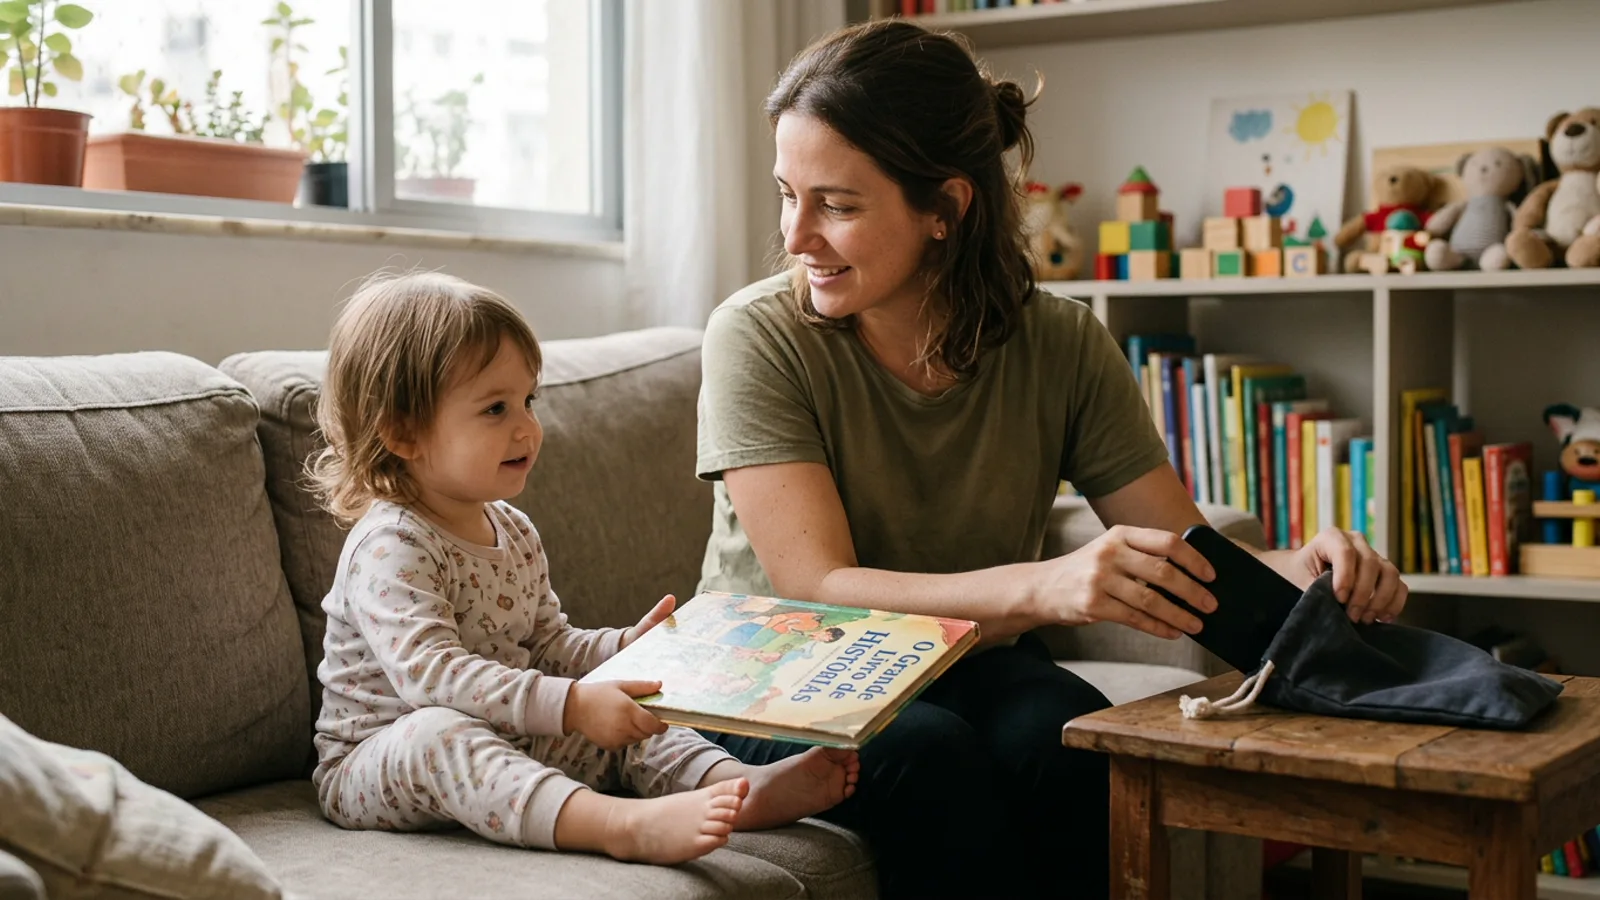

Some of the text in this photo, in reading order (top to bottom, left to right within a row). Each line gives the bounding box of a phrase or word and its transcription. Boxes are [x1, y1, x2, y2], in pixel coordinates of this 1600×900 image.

[1292, 253, 1308, 274] C
[912, 641, 935, 651] O
[790, 630, 891, 703] HISTÓRIAS
[851, 649, 898, 681] Livro
[857, 654, 921, 701] Grande
[828, 683, 857, 700] de
